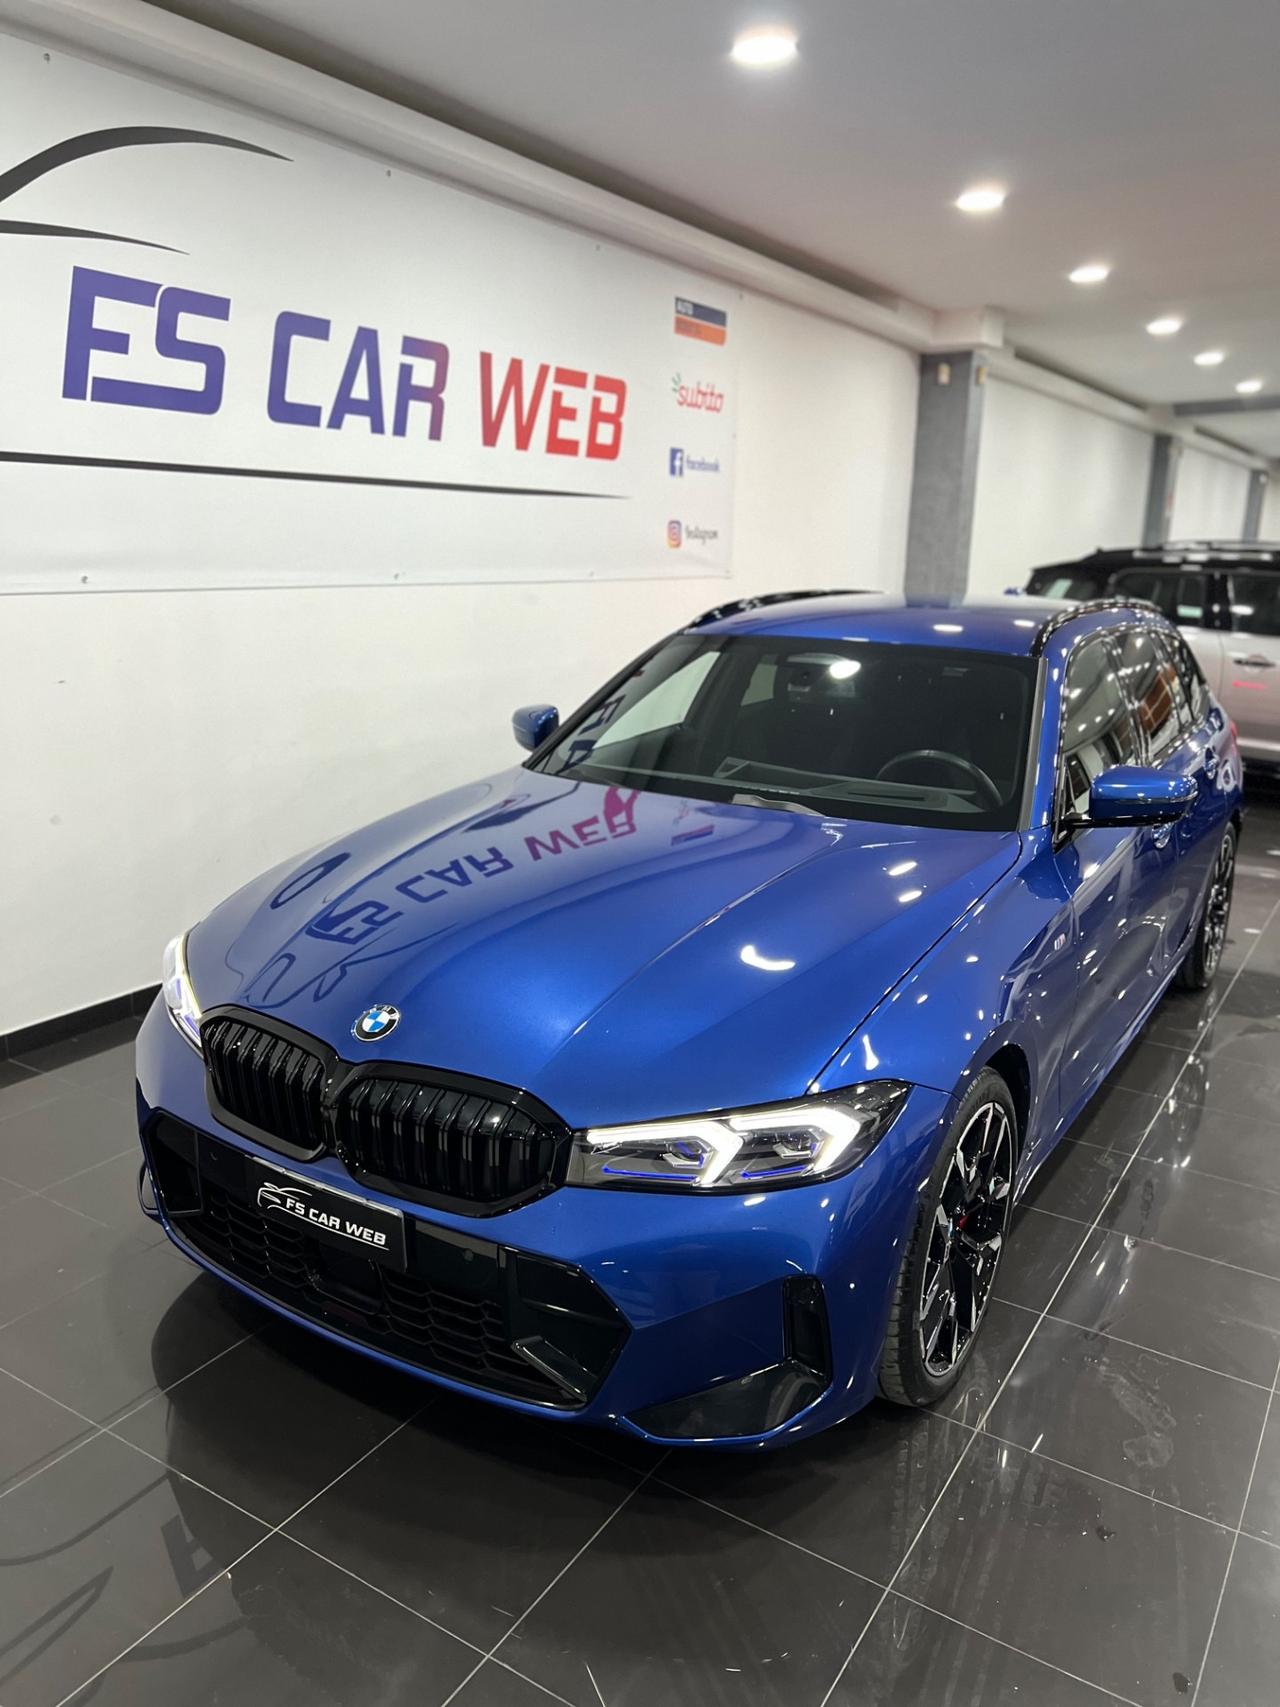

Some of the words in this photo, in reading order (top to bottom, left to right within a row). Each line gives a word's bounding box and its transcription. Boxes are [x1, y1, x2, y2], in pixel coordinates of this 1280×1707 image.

[267, 310, 449, 441] CAR
[479, 351, 627, 460] WEB
[286, 1198, 305, 1215] FS
[308, 1208, 340, 1229] CAR
[345, 1221, 386, 1245] WEB
